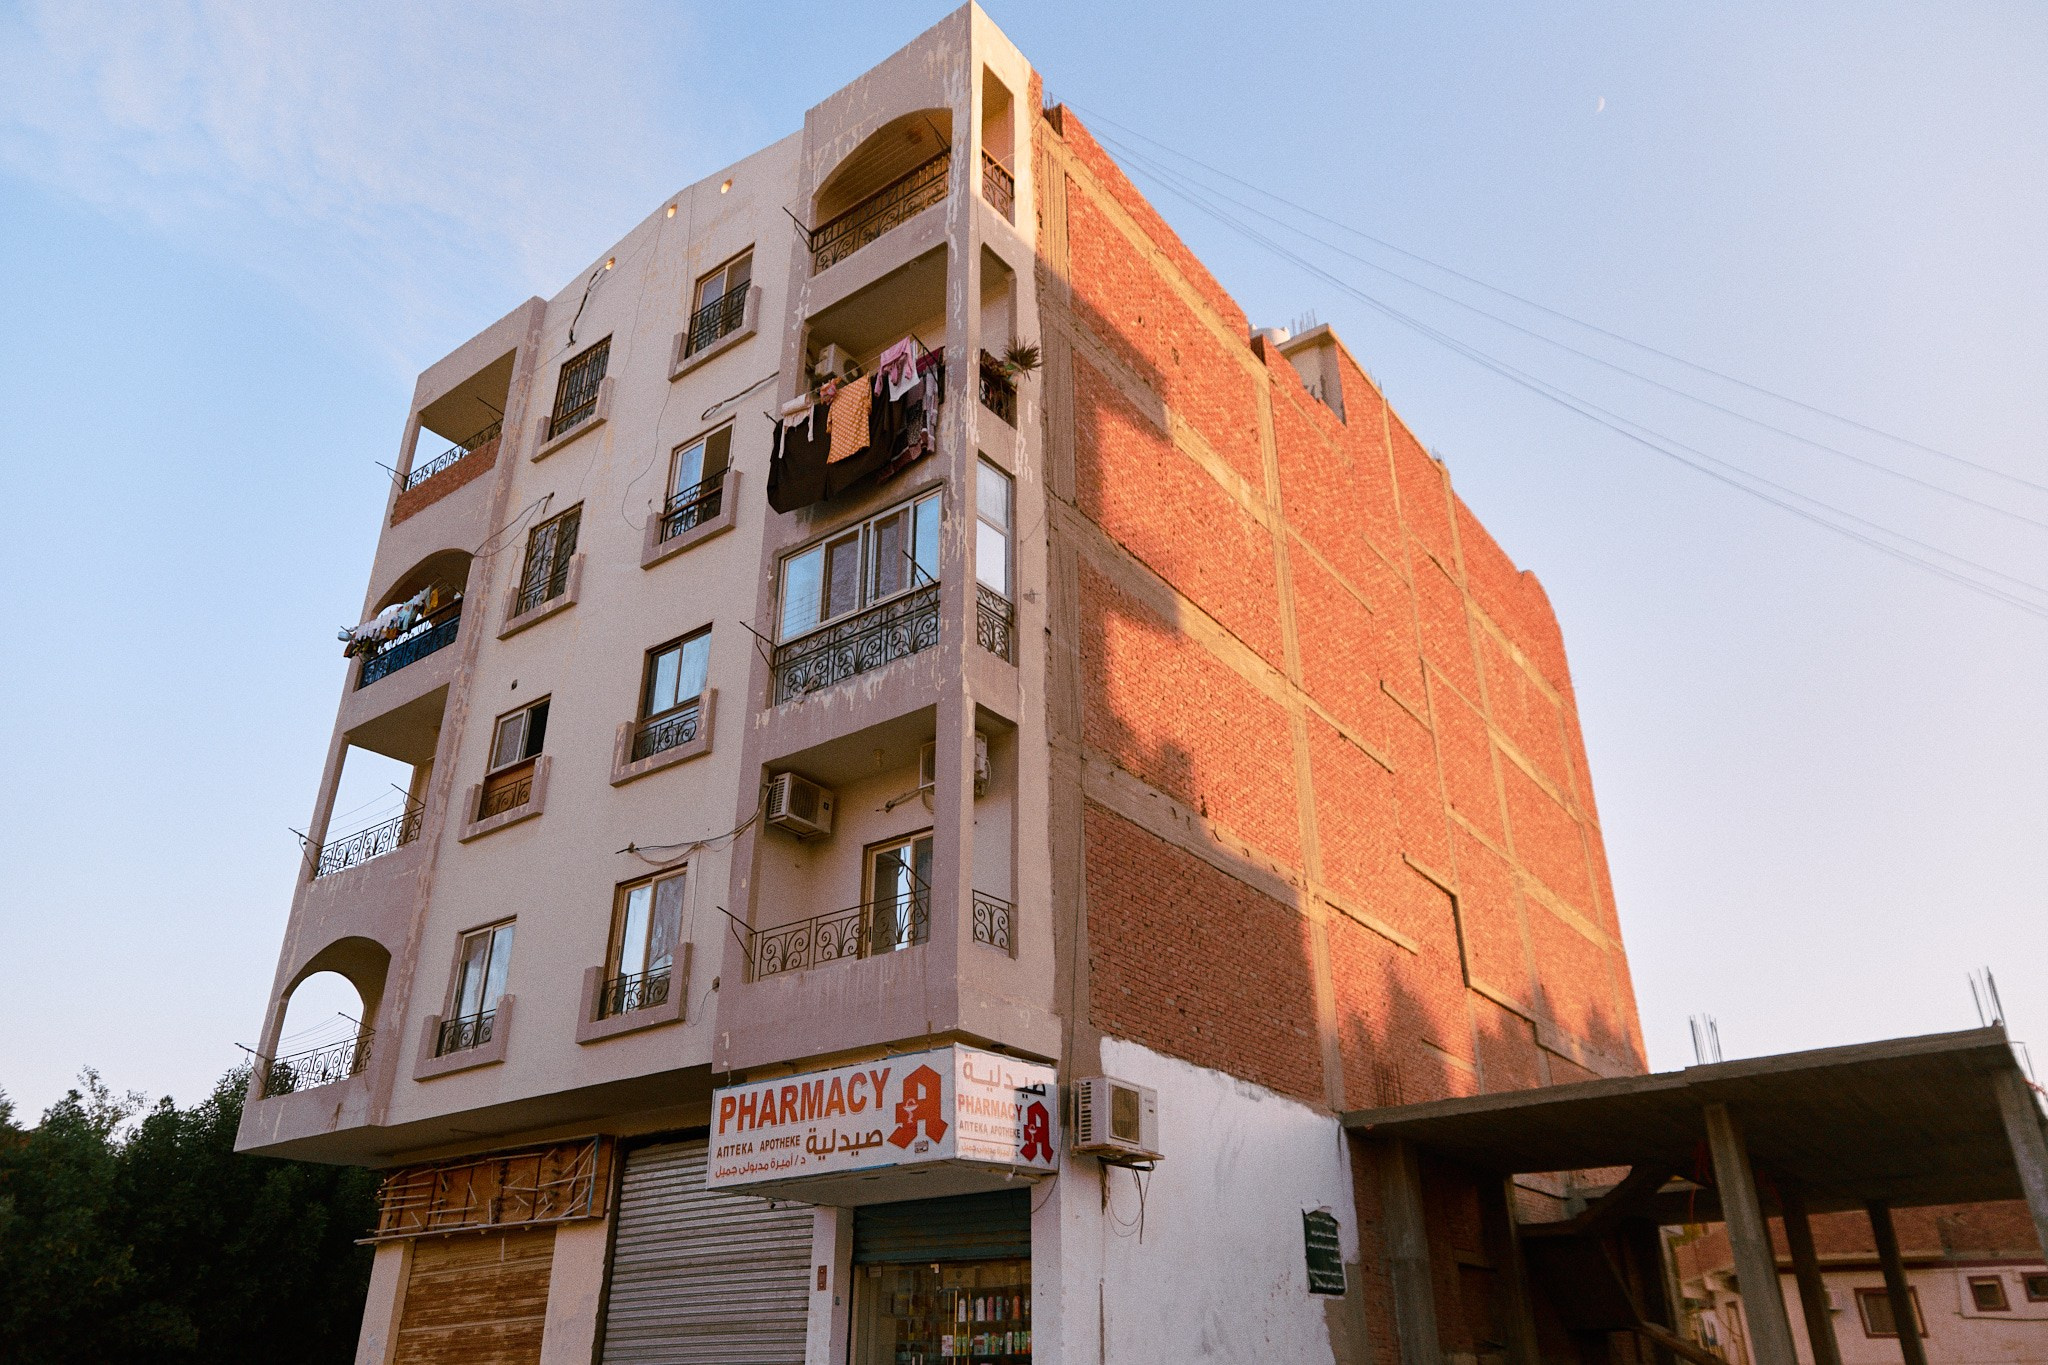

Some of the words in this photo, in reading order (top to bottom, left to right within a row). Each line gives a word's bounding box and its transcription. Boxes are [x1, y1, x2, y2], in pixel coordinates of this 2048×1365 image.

[963, 1054, 1047, 1099] صيدلية
[718, 1067, 892, 1135] PHARMACY
[957, 1093, 1023, 1121] PHARMACY
[716, 1142, 754, 1159] АПТЕКА
[759, 1134, 801, 1152] APOTHEKE
[805, 1127, 884, 1161] صيدلية
